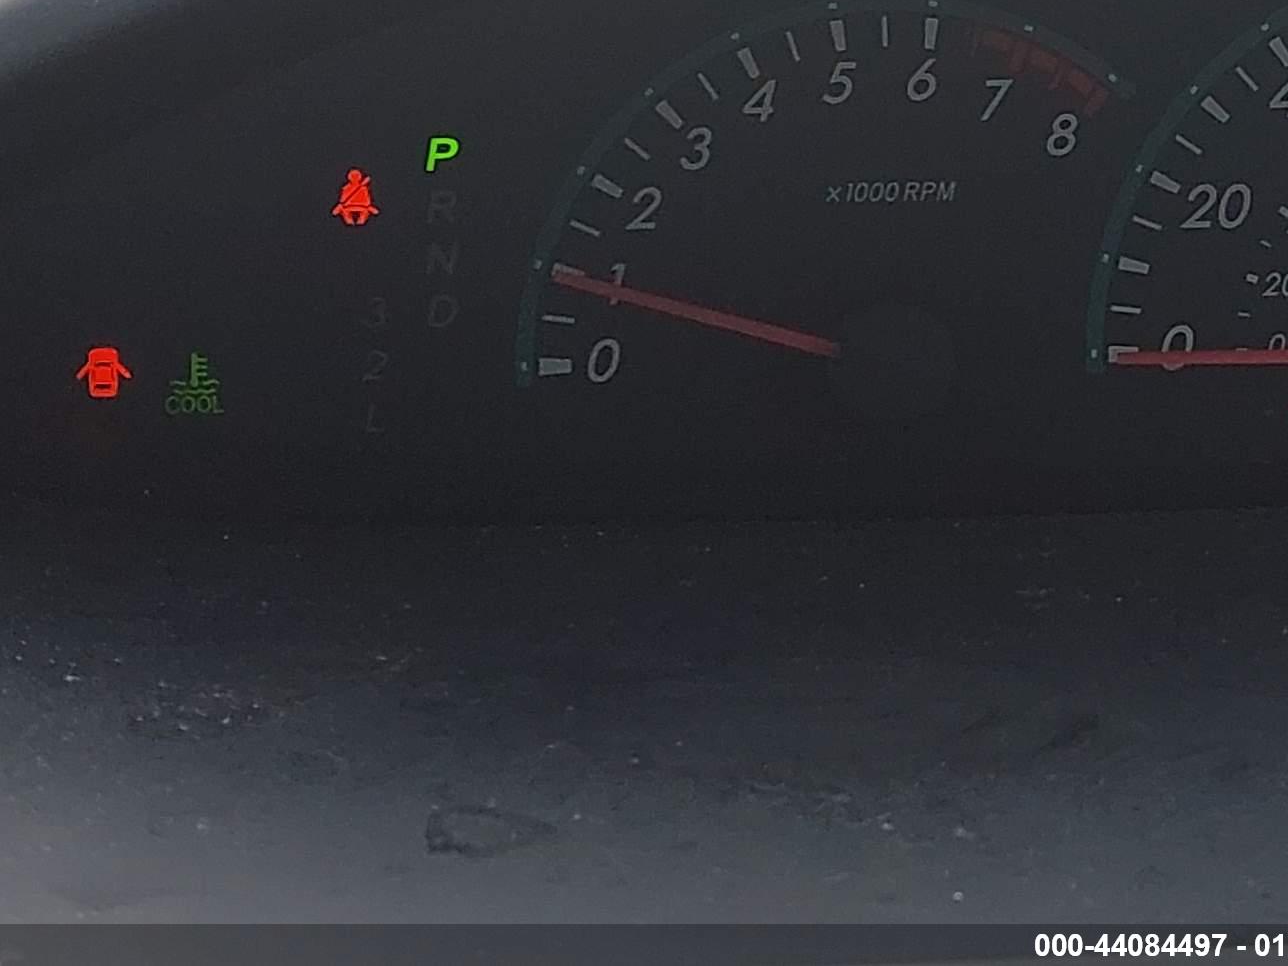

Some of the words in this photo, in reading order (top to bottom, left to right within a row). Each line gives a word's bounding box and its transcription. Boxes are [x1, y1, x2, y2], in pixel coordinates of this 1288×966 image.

[742, 79, 777, 122] 4
[821, 61, 856, 104] 5
[907, 59, 937, 101] 6
[980, 78, 1014, 122] 7
[425, 135, 460, 173] P
[679, 126, 713, 170] 3
[1045, 113, 1078, 157] 8
[427, 190, 457, 224] R
[625, 187, 662, 231] 2
[904, 182, 956, 202] RPM
[1181, 182, 1252, 231] 20
[587, 339, 621, 384] 0
[165, 395, 224, 415] COOL
